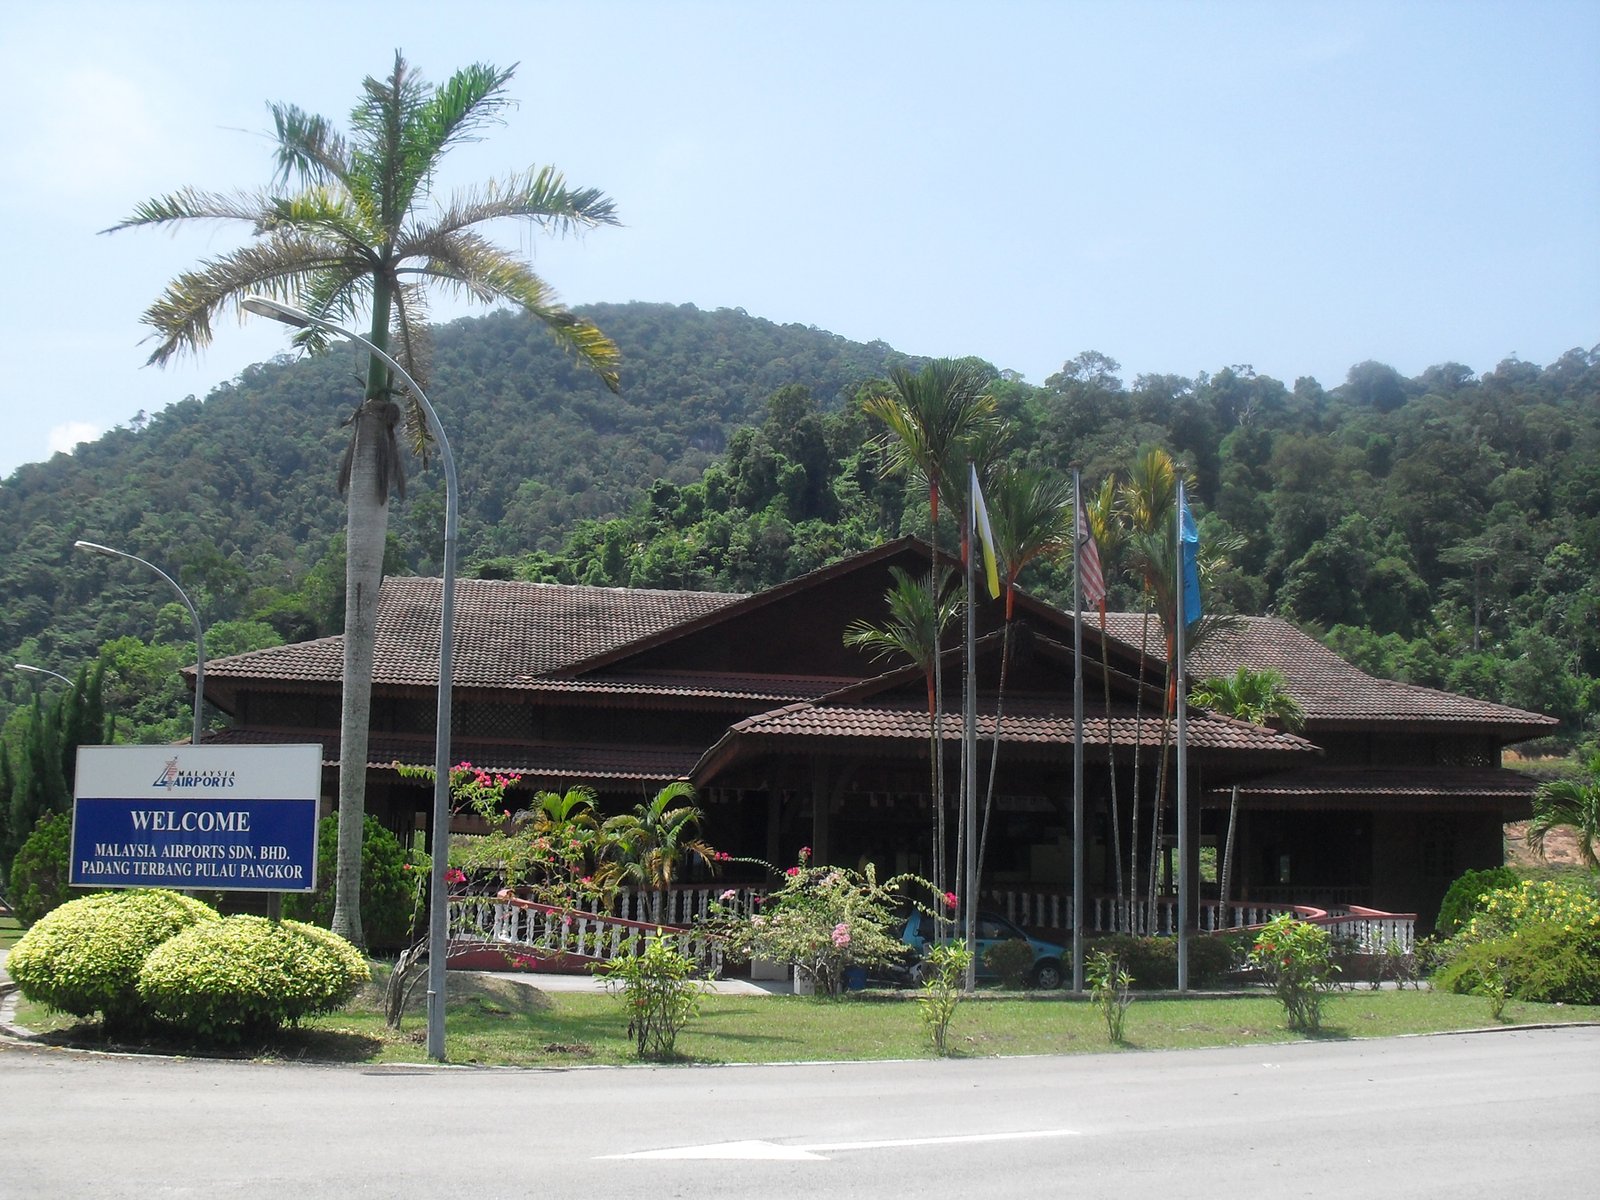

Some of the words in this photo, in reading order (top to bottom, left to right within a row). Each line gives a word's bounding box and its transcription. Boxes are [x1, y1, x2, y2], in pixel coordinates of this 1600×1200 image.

[173, 776, 235, 788] AIRPORTS
[130, 810, 251, 832] WELCOME
[95, 843, 157, 859] MALAYSIA
[161, 844, 225, 860] AIRPORTS
[228, 846, 257, 860] SDN.
[260, 847, 290, 861] BHD.
[81, 860, 130, 876] PADANG
[133, 861, 192, 877] TERBANG
[195, 863, 237, 878] PULAU
[240, 864, 303, 880] PANGKOR
